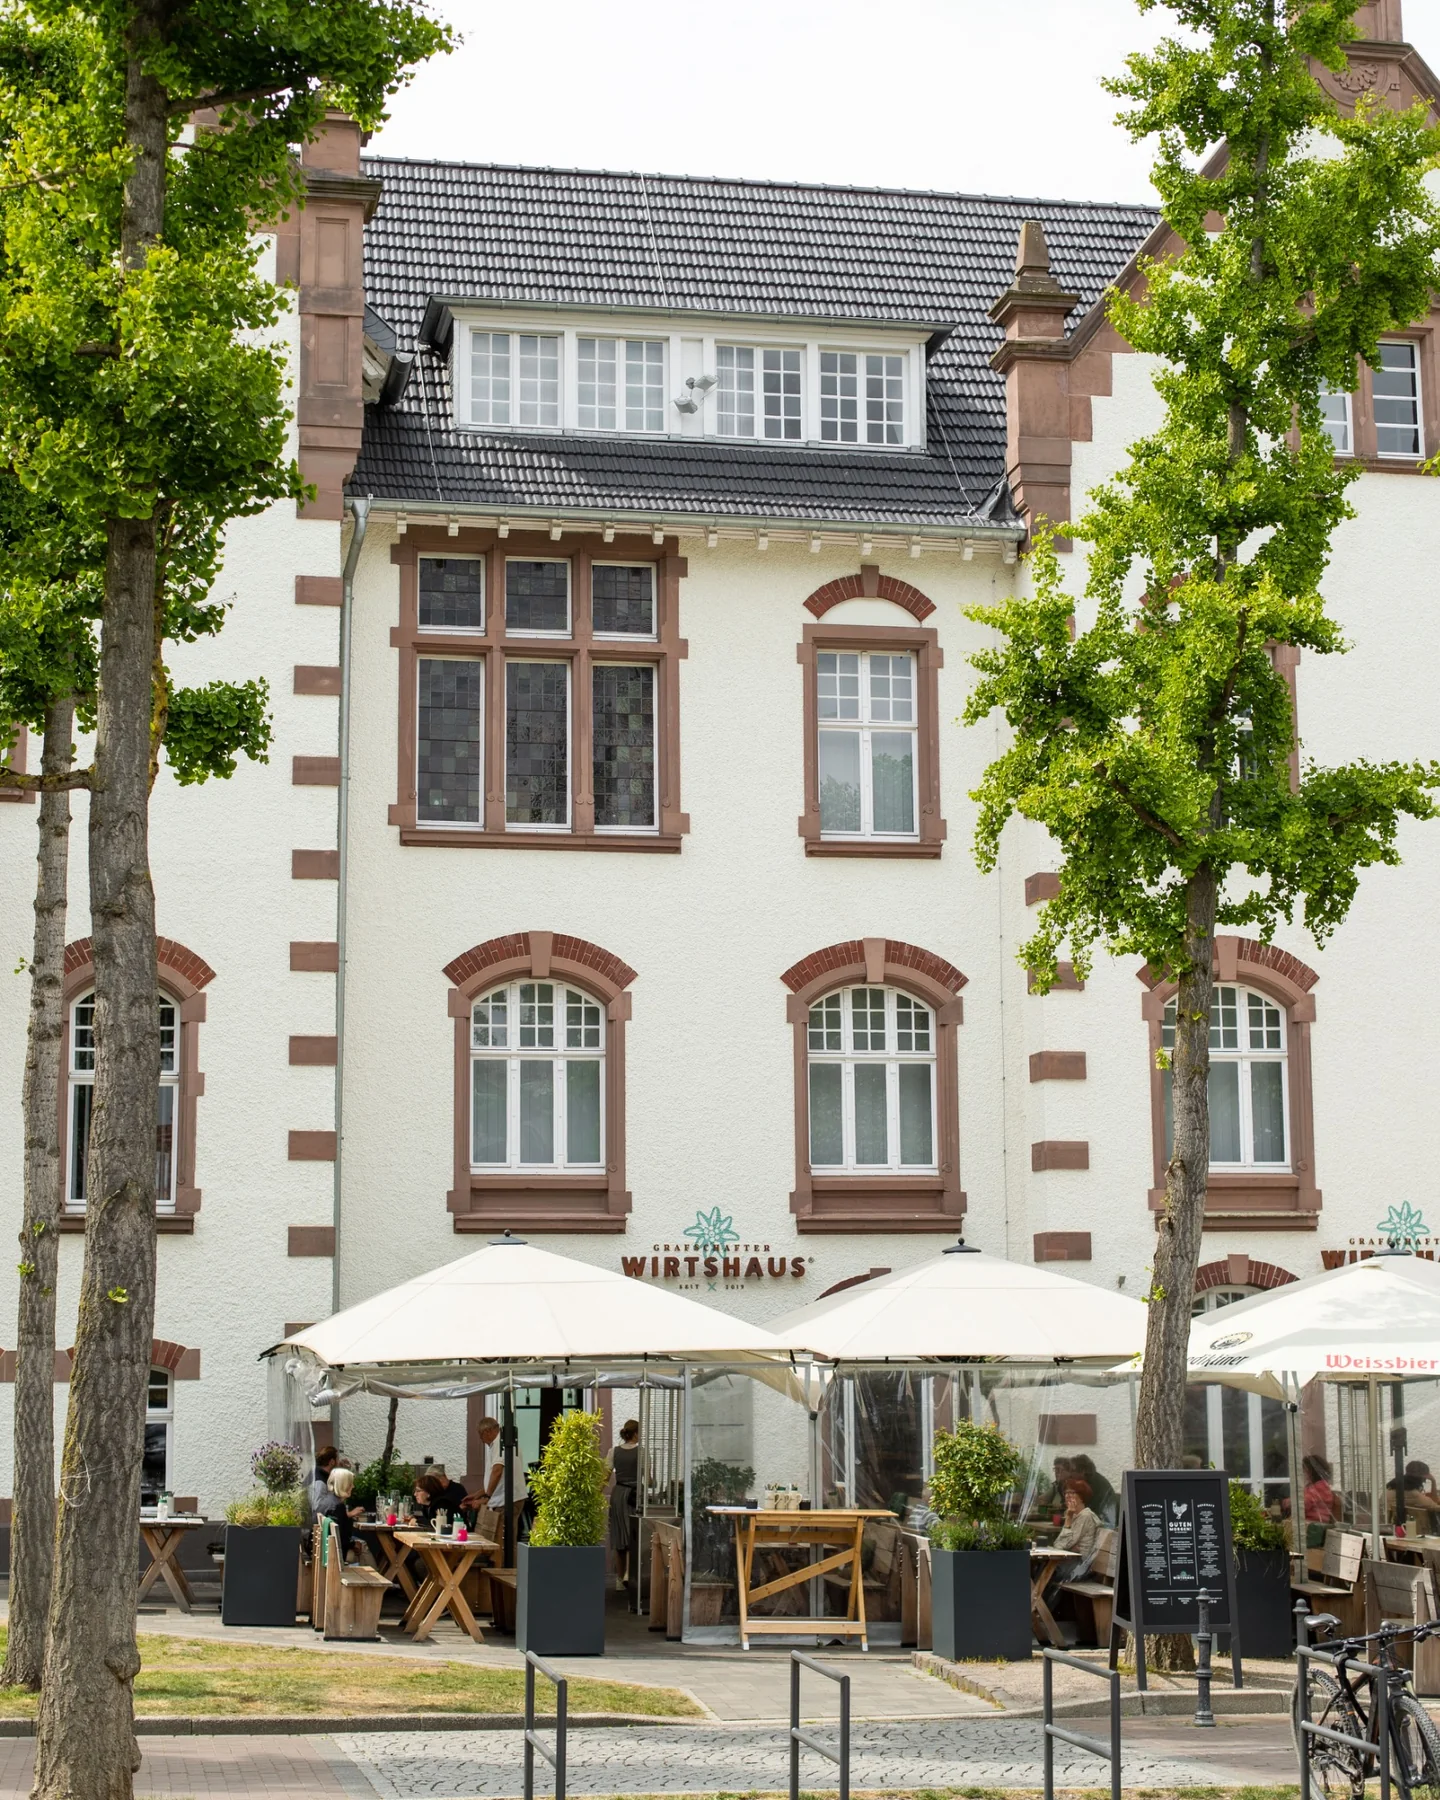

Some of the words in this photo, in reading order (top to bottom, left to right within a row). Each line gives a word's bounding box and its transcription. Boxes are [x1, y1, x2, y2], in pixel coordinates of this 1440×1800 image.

[653, 1243, 771, 1252] GRAFSCHAFTER
[621, 1256, 806, 1278] WIRTSHAUS
[1325, 1354, 1440, 1369] Weissbier
